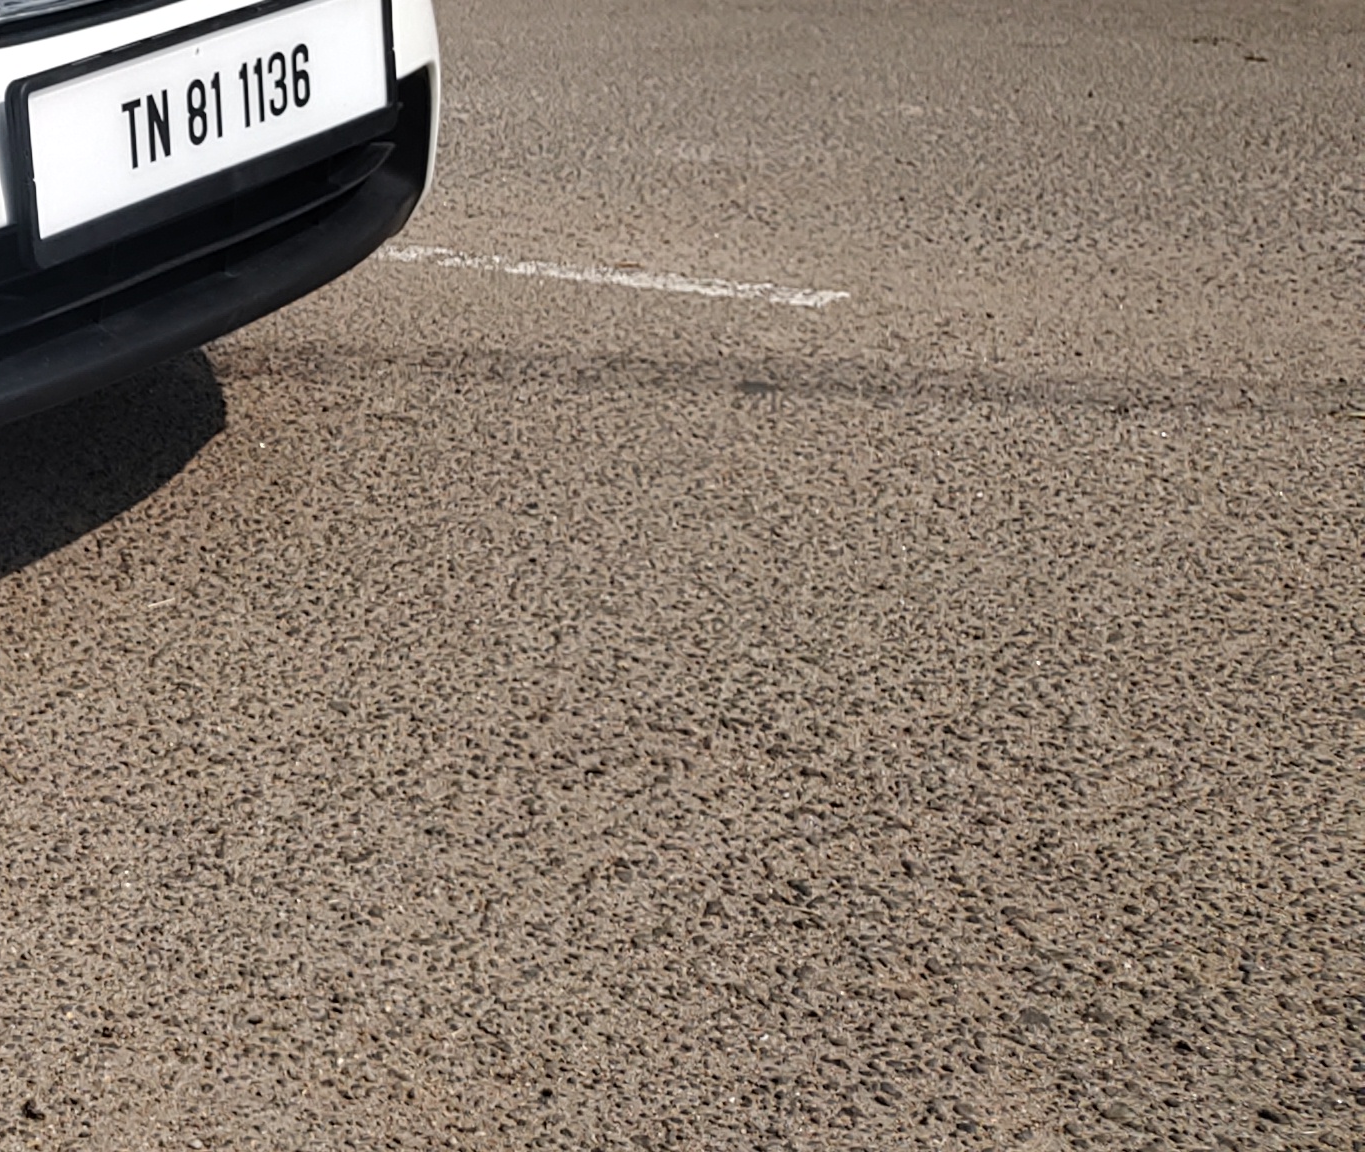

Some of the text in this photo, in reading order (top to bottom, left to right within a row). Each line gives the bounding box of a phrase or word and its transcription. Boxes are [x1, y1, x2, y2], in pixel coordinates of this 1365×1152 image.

[121, 43, 311, 169] TN 81 1136
